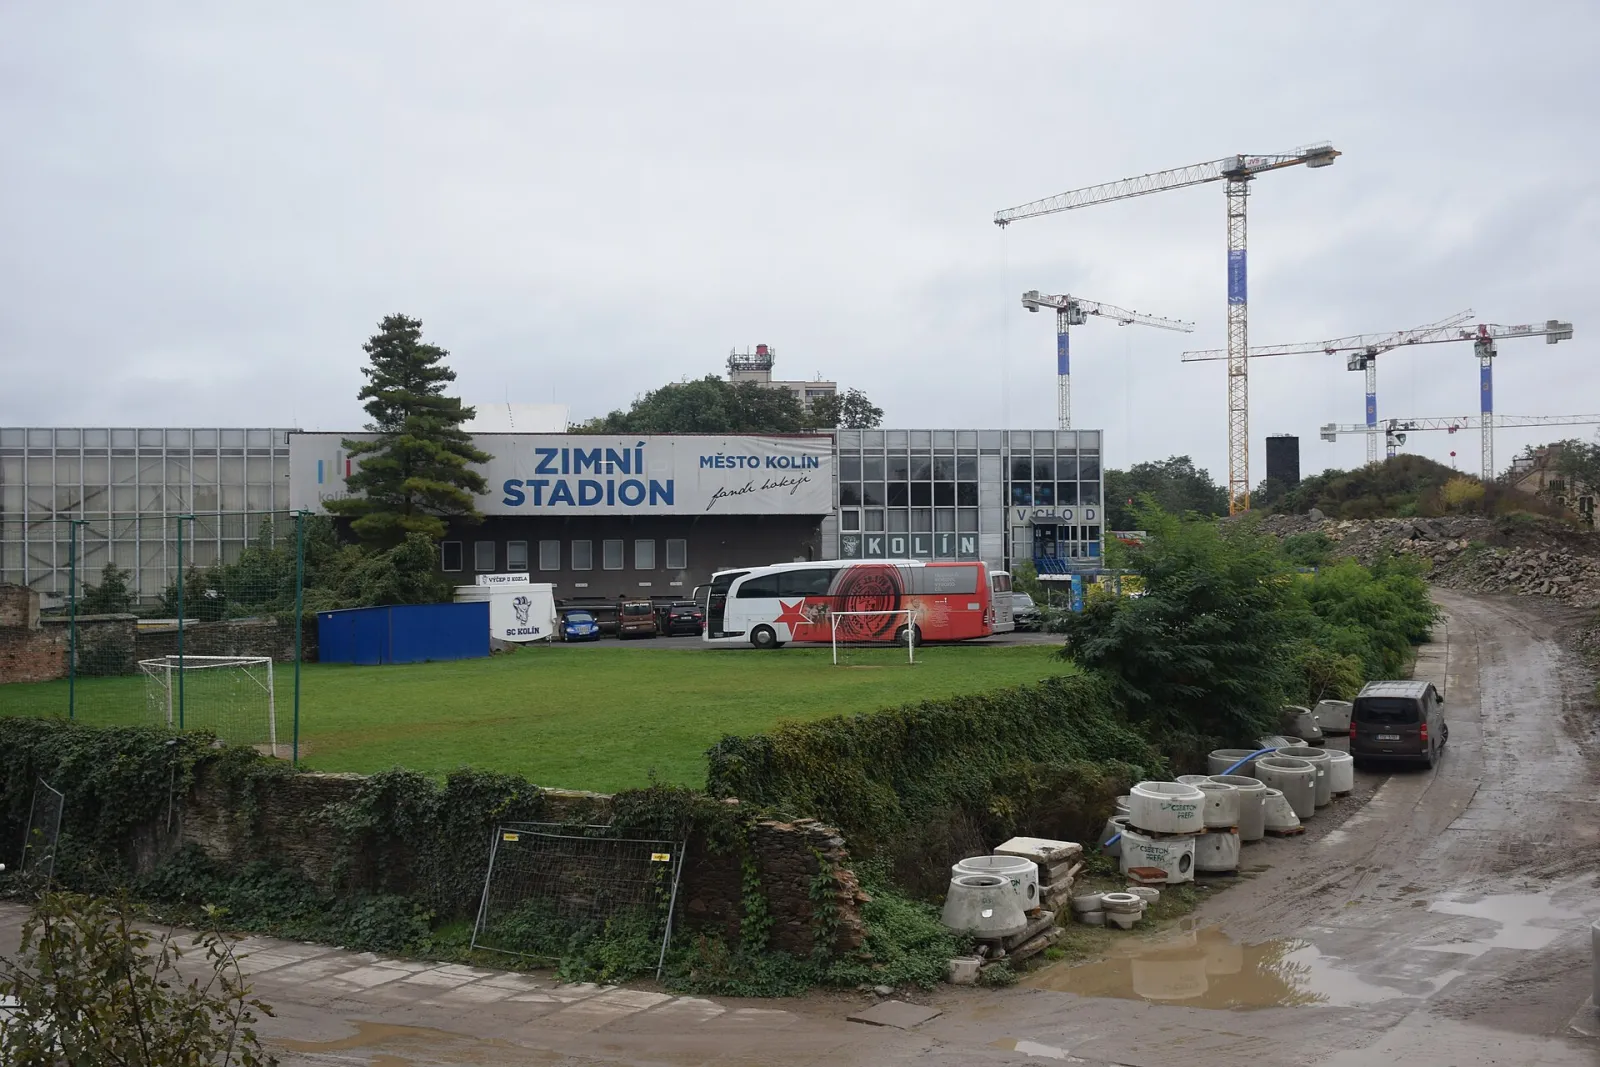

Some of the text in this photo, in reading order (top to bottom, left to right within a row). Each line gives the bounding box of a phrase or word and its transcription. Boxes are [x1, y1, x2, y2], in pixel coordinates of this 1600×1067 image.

[535, 441, 646, 475] ZIMNÍ
[699, 452, 819, 469] MĚSTO KOLÍN
[502, 479, 674, 507] STADION
[760, 470, 811, 495] hokeji
[868, 534, 975, 554] KOLÍN
[517, 626, 540, 636] KOLÍN
